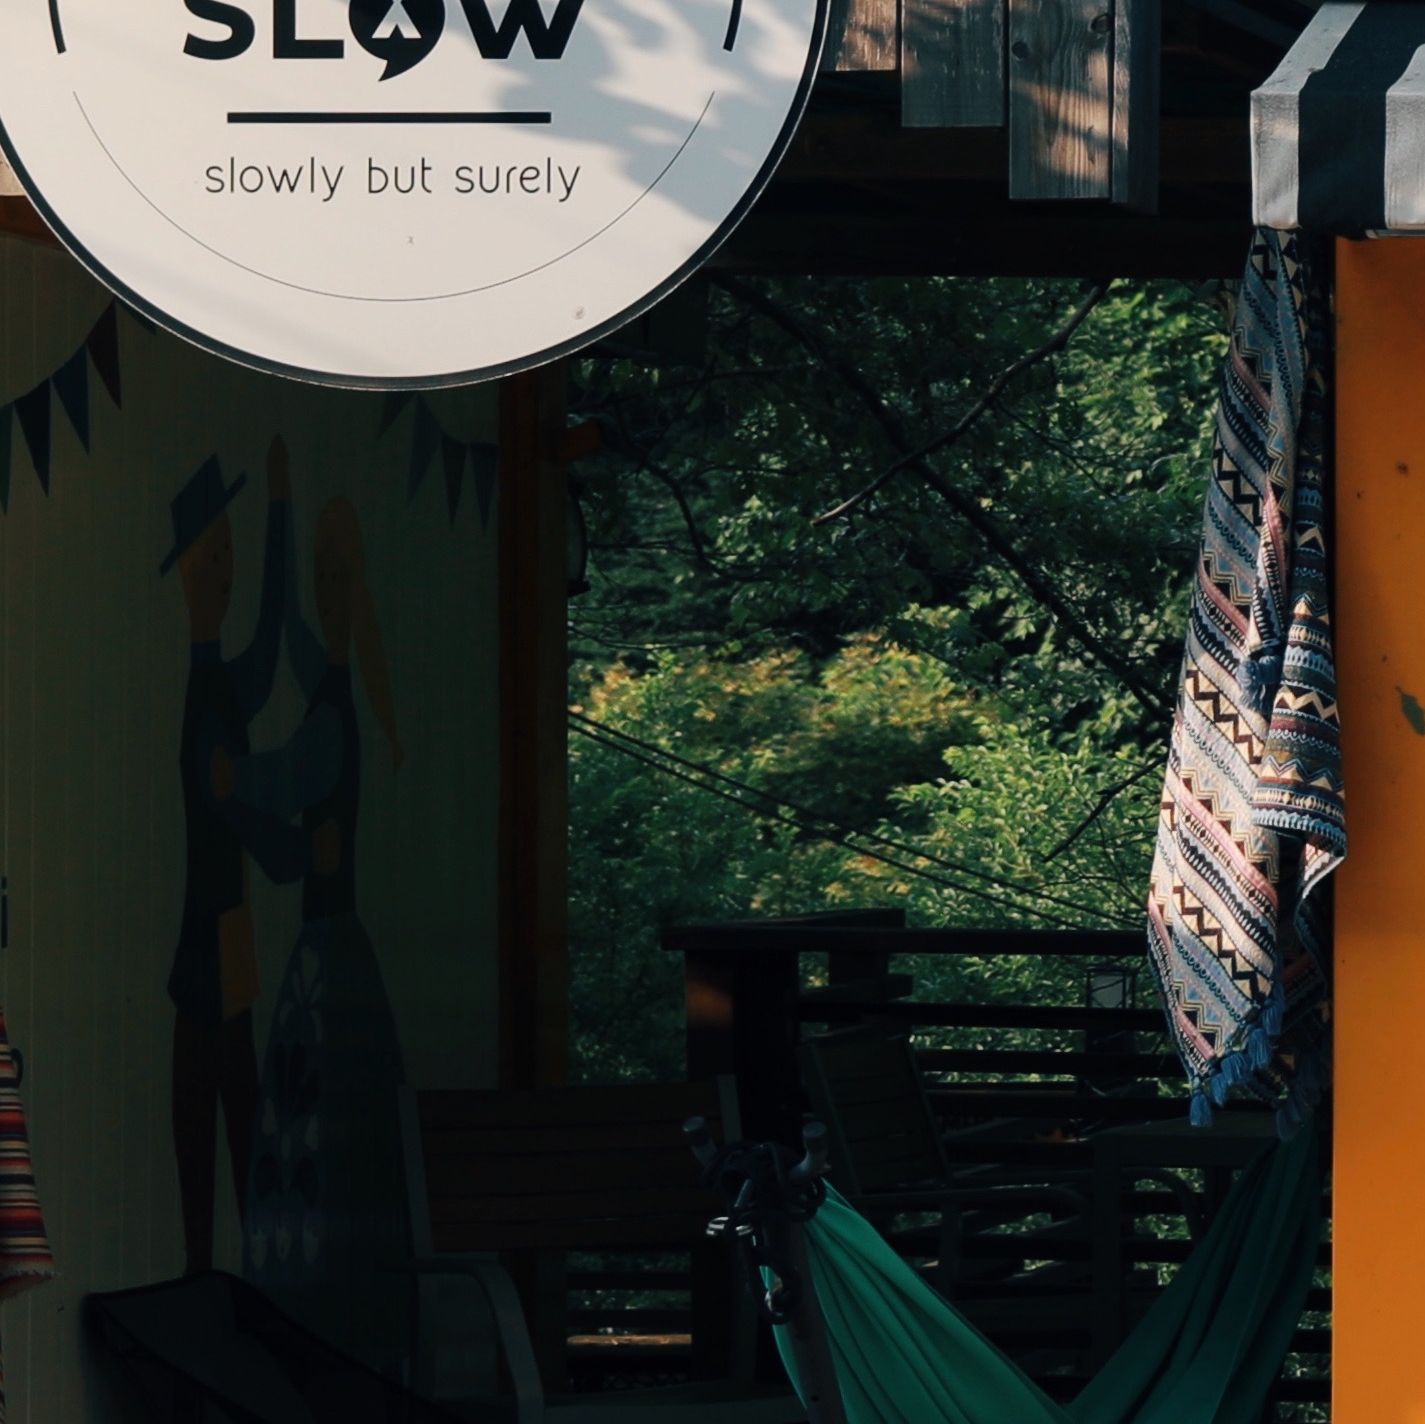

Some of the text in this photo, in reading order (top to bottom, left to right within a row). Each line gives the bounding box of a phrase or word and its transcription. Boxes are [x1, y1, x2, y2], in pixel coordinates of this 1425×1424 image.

[204, 157, 582, 202] slowly but surely
